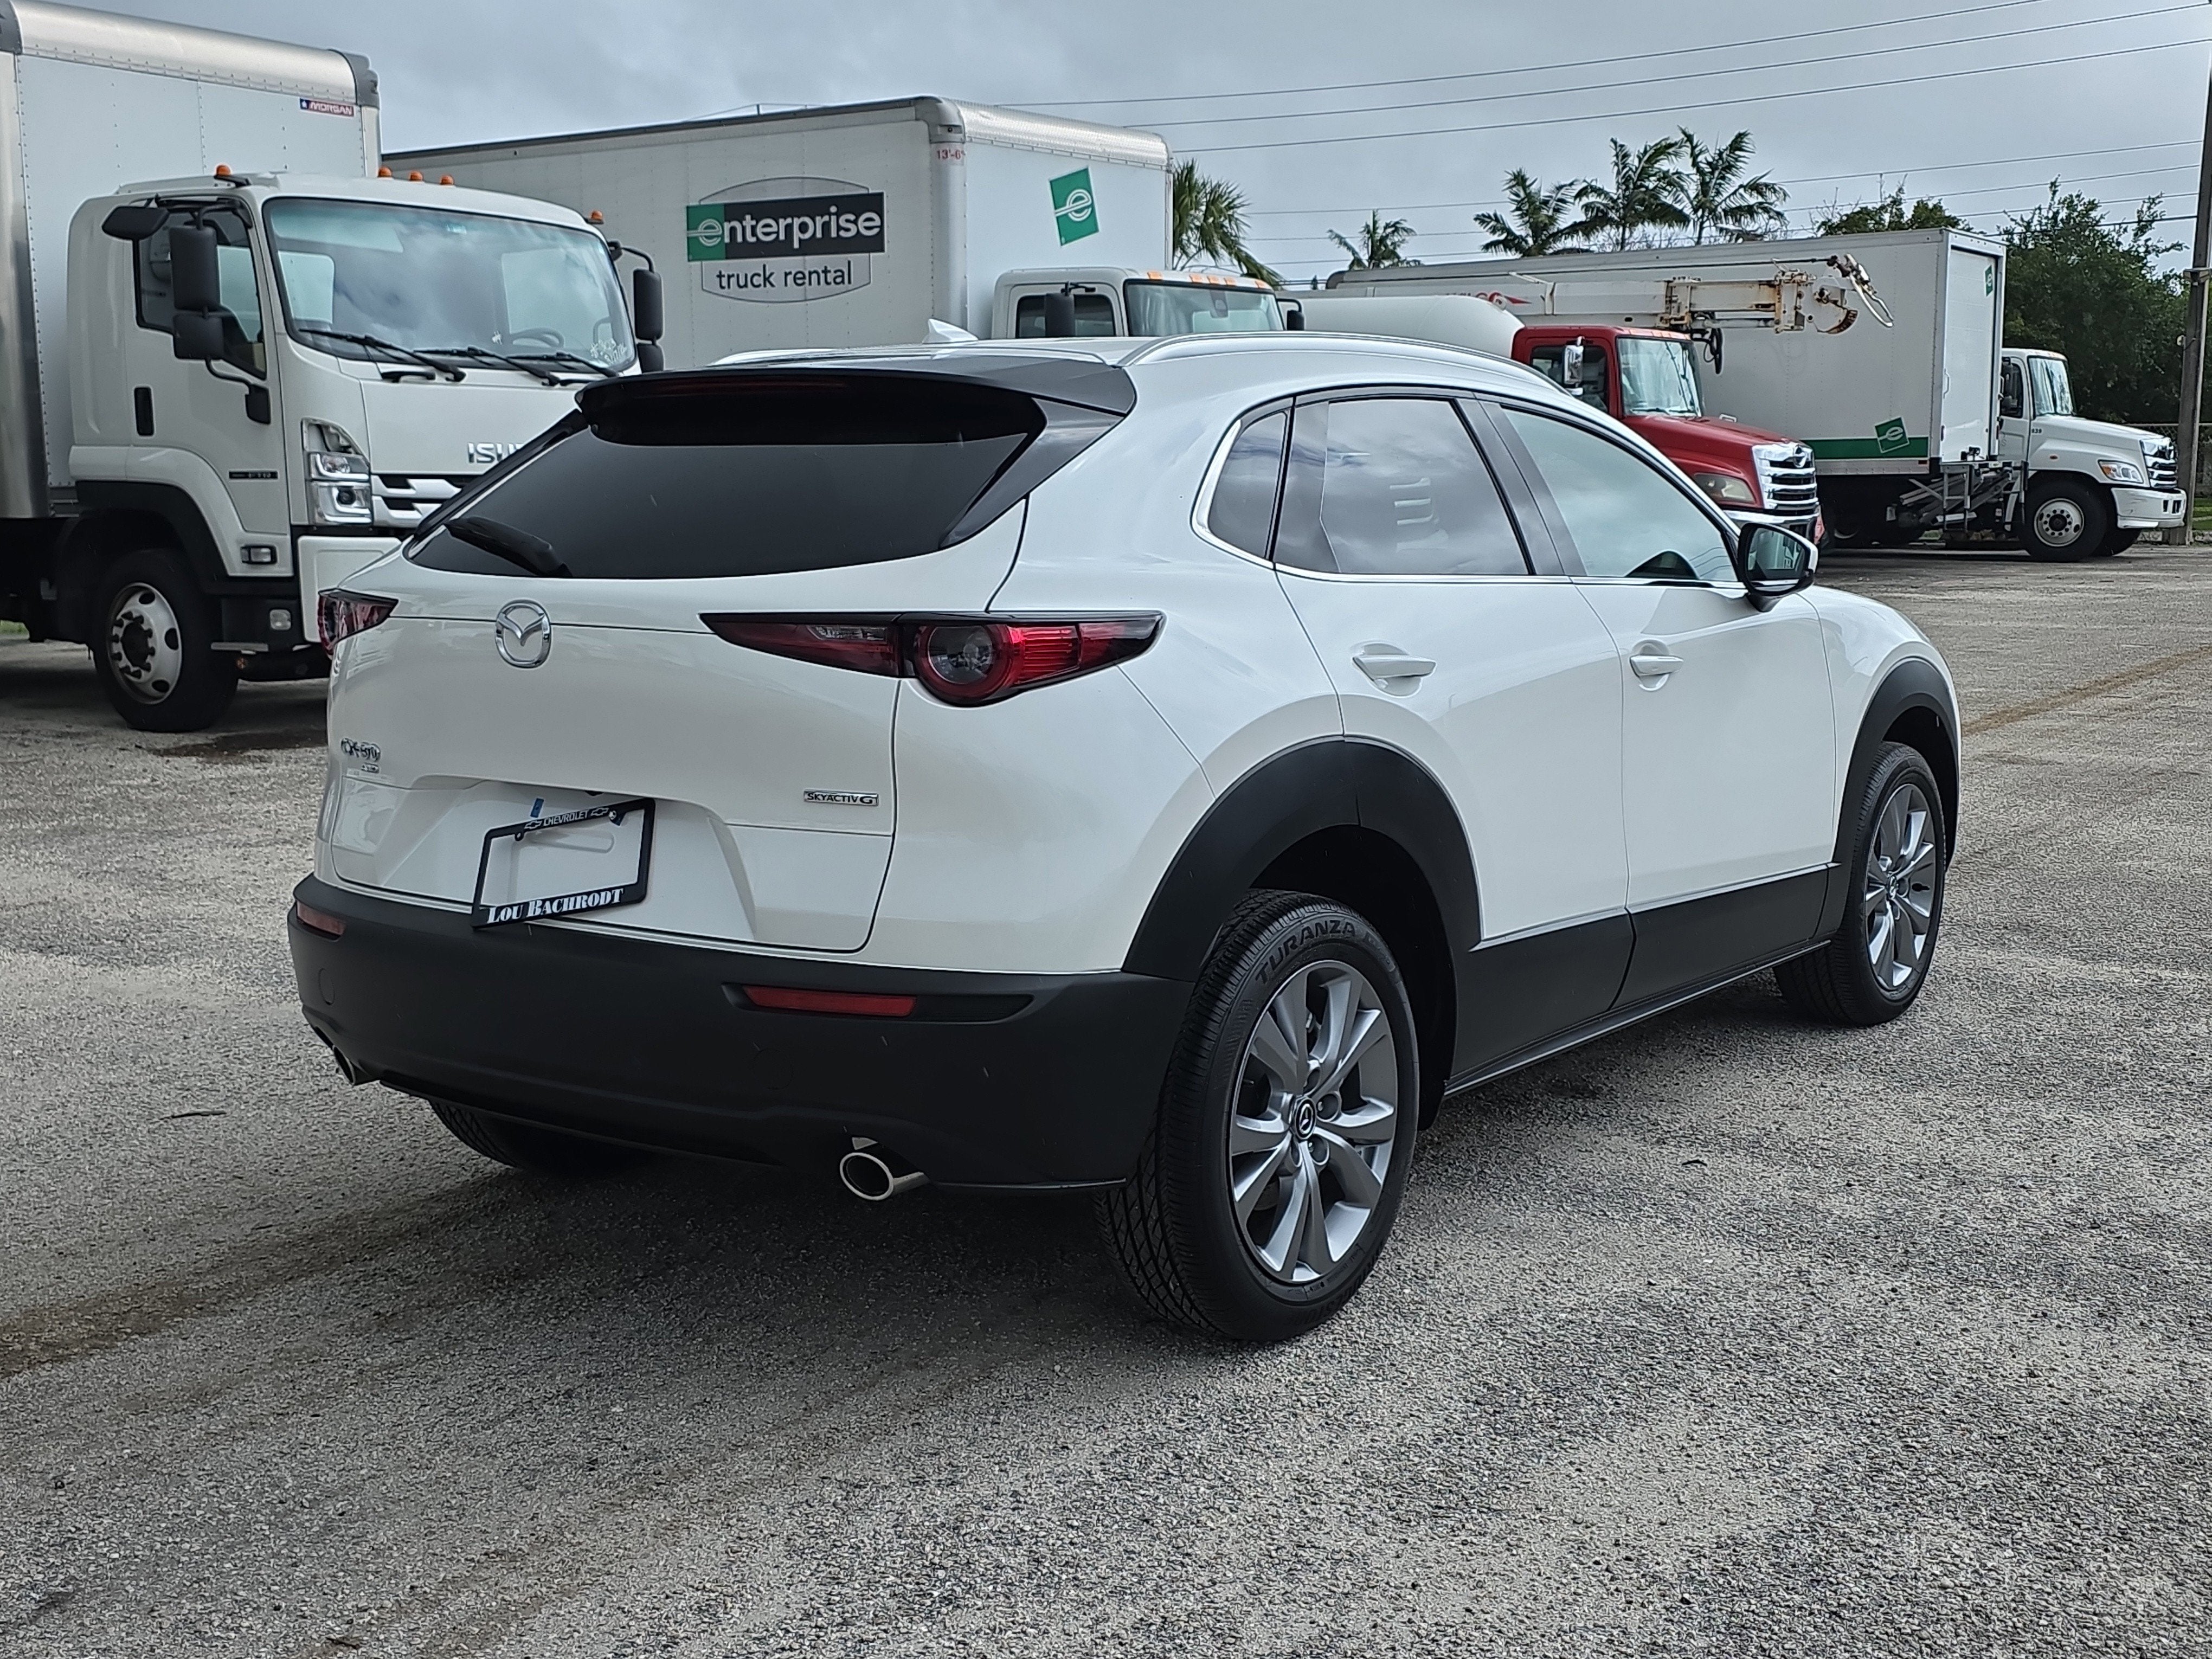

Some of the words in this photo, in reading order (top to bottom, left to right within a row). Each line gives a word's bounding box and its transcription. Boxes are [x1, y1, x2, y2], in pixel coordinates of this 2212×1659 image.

[310, 101, 352, 115] MORGAN
[687, 205, 882, 249] enterprise
[716, 263, 775, 289] truck
[784, 260, 852, 287] rental
[543, 810, 589, 826] CHEVROLET
[487, 904, 523, 924] LOU
[526, 888, 623, 918] BACHRODT
[1255, 919, 1355, 984] TURANZA
